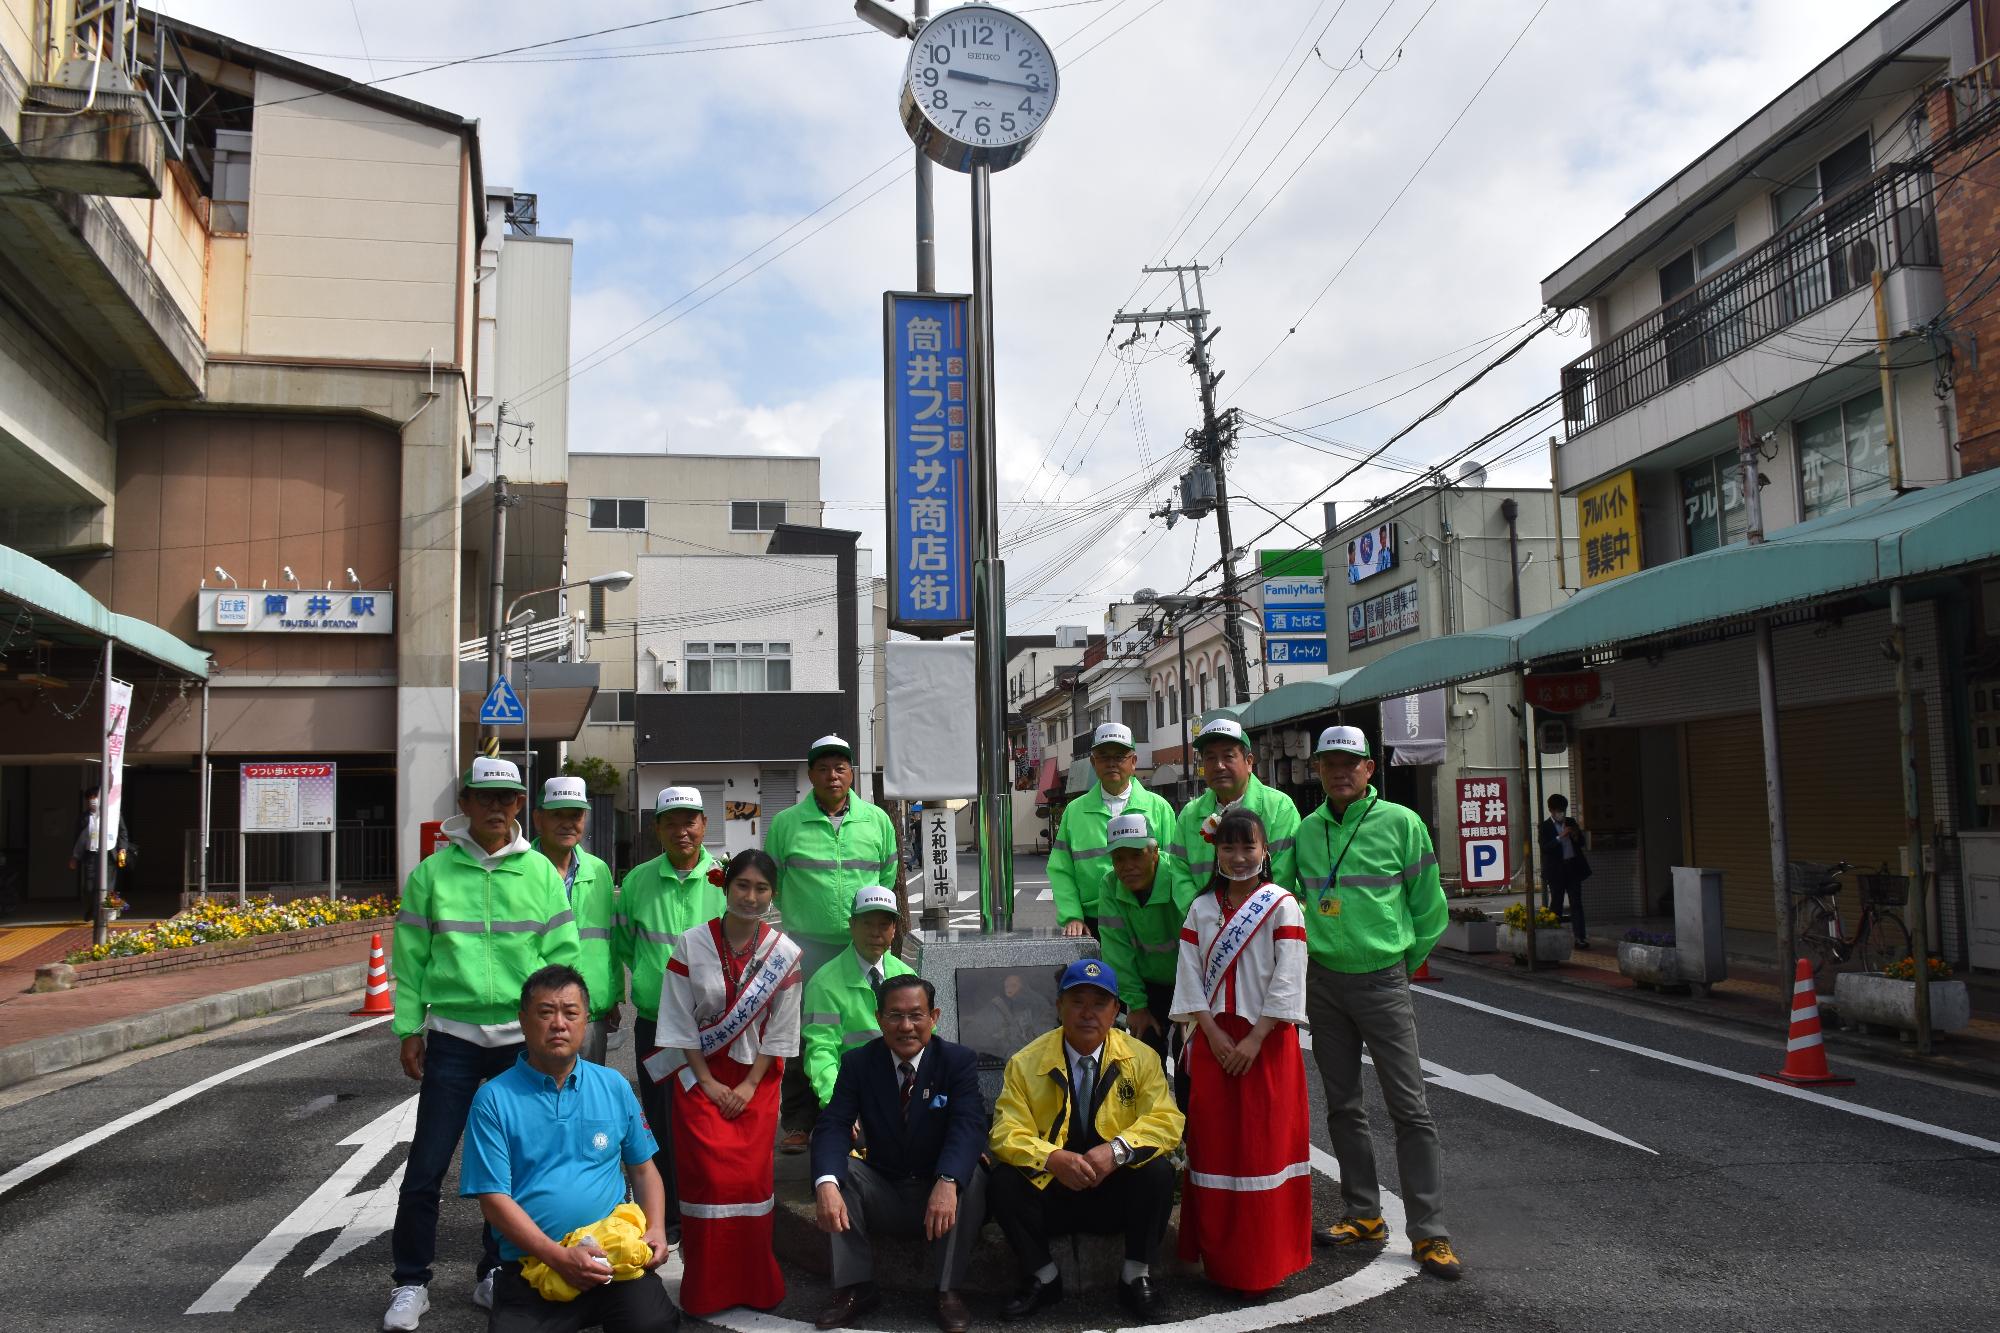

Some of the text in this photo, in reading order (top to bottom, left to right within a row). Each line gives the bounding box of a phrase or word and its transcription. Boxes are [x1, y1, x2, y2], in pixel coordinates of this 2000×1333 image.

[951, 28, 967, 49] 11
[973, 25, 994, 46] 12
[1005, 33, 1010, 52] 1
[929, 45, 951, 65] 10
[967, 52, 1000, 61] SEIKO
[1018, 50, 1034, 69] 2
[923, 67, 939, 87] 9
[1025, 74, 1040, 93] 3
[932, 89, 948, 110] 8
[1018, 96, 1034, 116] 4
[951, 109, 967, 129] 7
[974, 116, 991, 137] 6
[1000, 112, 1016, 132] 5
[948, 358, 964, 450] お買物は
[906, 315, 950, 612] 筒井プラザ商店街
[1583, 484, 1628, 528] アルバイト
[1586, 528, 1630, 579] 募集中
[1265, 584, 1324, 597] FamilyMart
[220, 599, 246, 612] 近鉄
[264, 594, 376, 616] 筒井駅
[1366, 586, 1418, 623] 警備員募集中
[280, 619, 358, 629] TSUTSUI STATION
[1272, 614, 1322, 629] 酒 たばこ
[1292, 645, 1321, 657] イートイン
[251, 767, 325, 775] つつい歩いてマップ
[1472, 783, 1500, 798] 焼肉
[1461, 799, 1506, 824] 筒井
[1461, 826, 1507, 837] 専用駐車場
[1473, 845, 1497, 878] P
